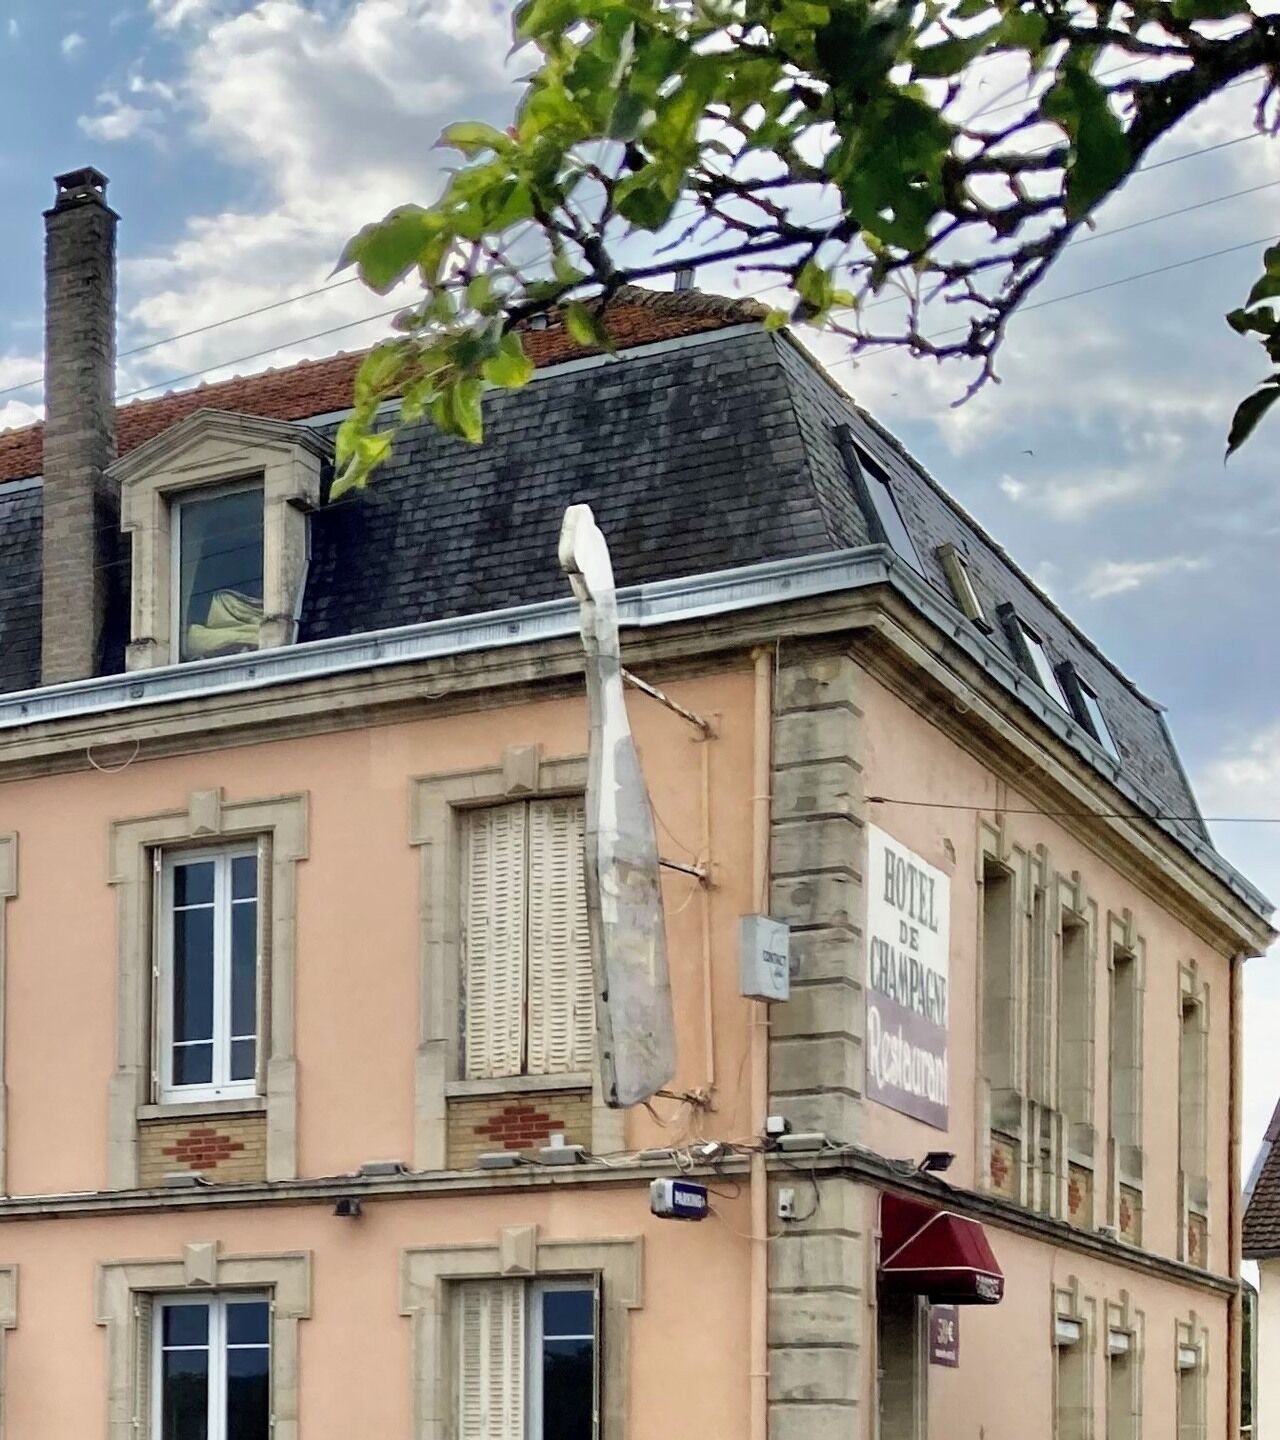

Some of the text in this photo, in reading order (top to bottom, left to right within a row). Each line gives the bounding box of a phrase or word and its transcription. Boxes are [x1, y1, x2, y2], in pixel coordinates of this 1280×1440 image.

[883, 847, 937, 933] HOTEL
[899, 919, 920, 952] DE
[869, 1004, 948, 1106] Restaurant
